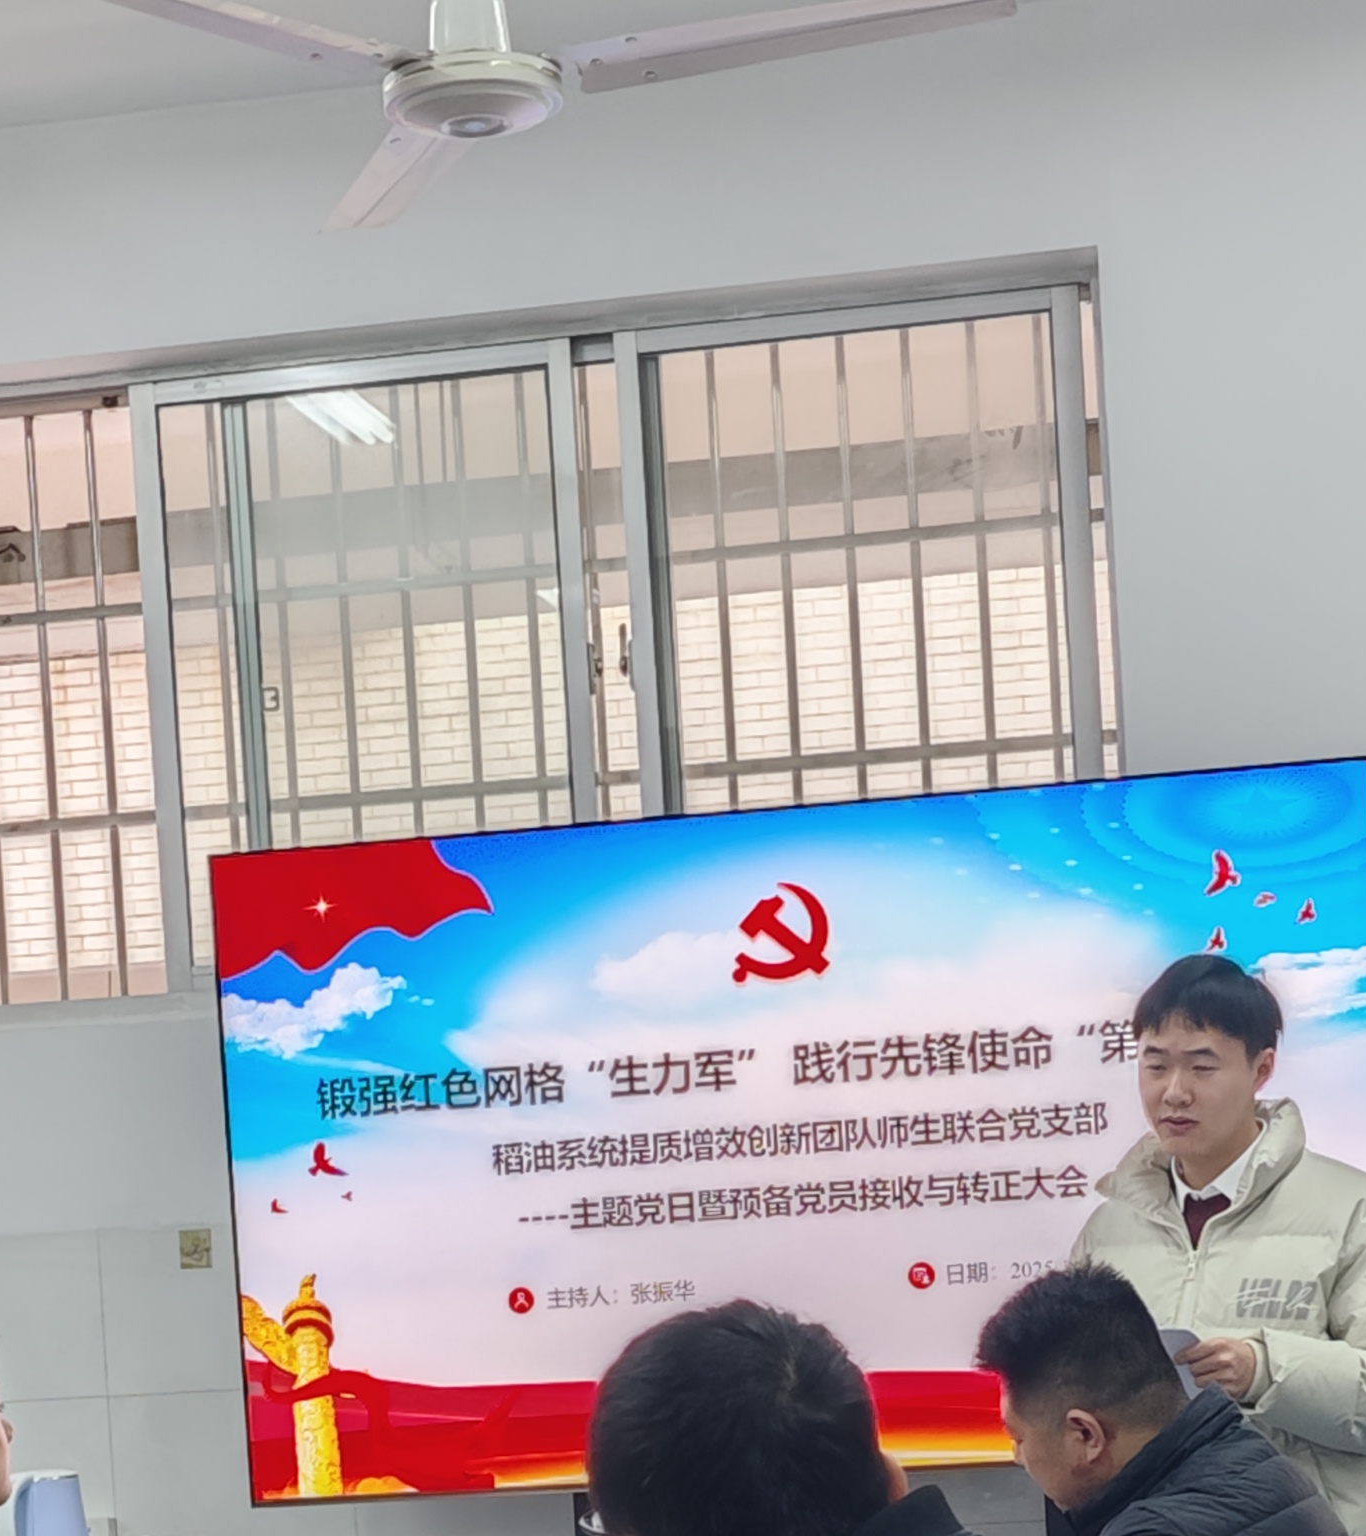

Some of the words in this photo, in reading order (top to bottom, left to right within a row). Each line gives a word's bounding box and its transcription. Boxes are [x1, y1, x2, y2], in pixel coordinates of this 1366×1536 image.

[316, 1047, 756, 1121] 锻强红色网格“生力军”
[492, 1101, 1110, 1177] 稻油系统提质增效创新团队师生联合党支部
